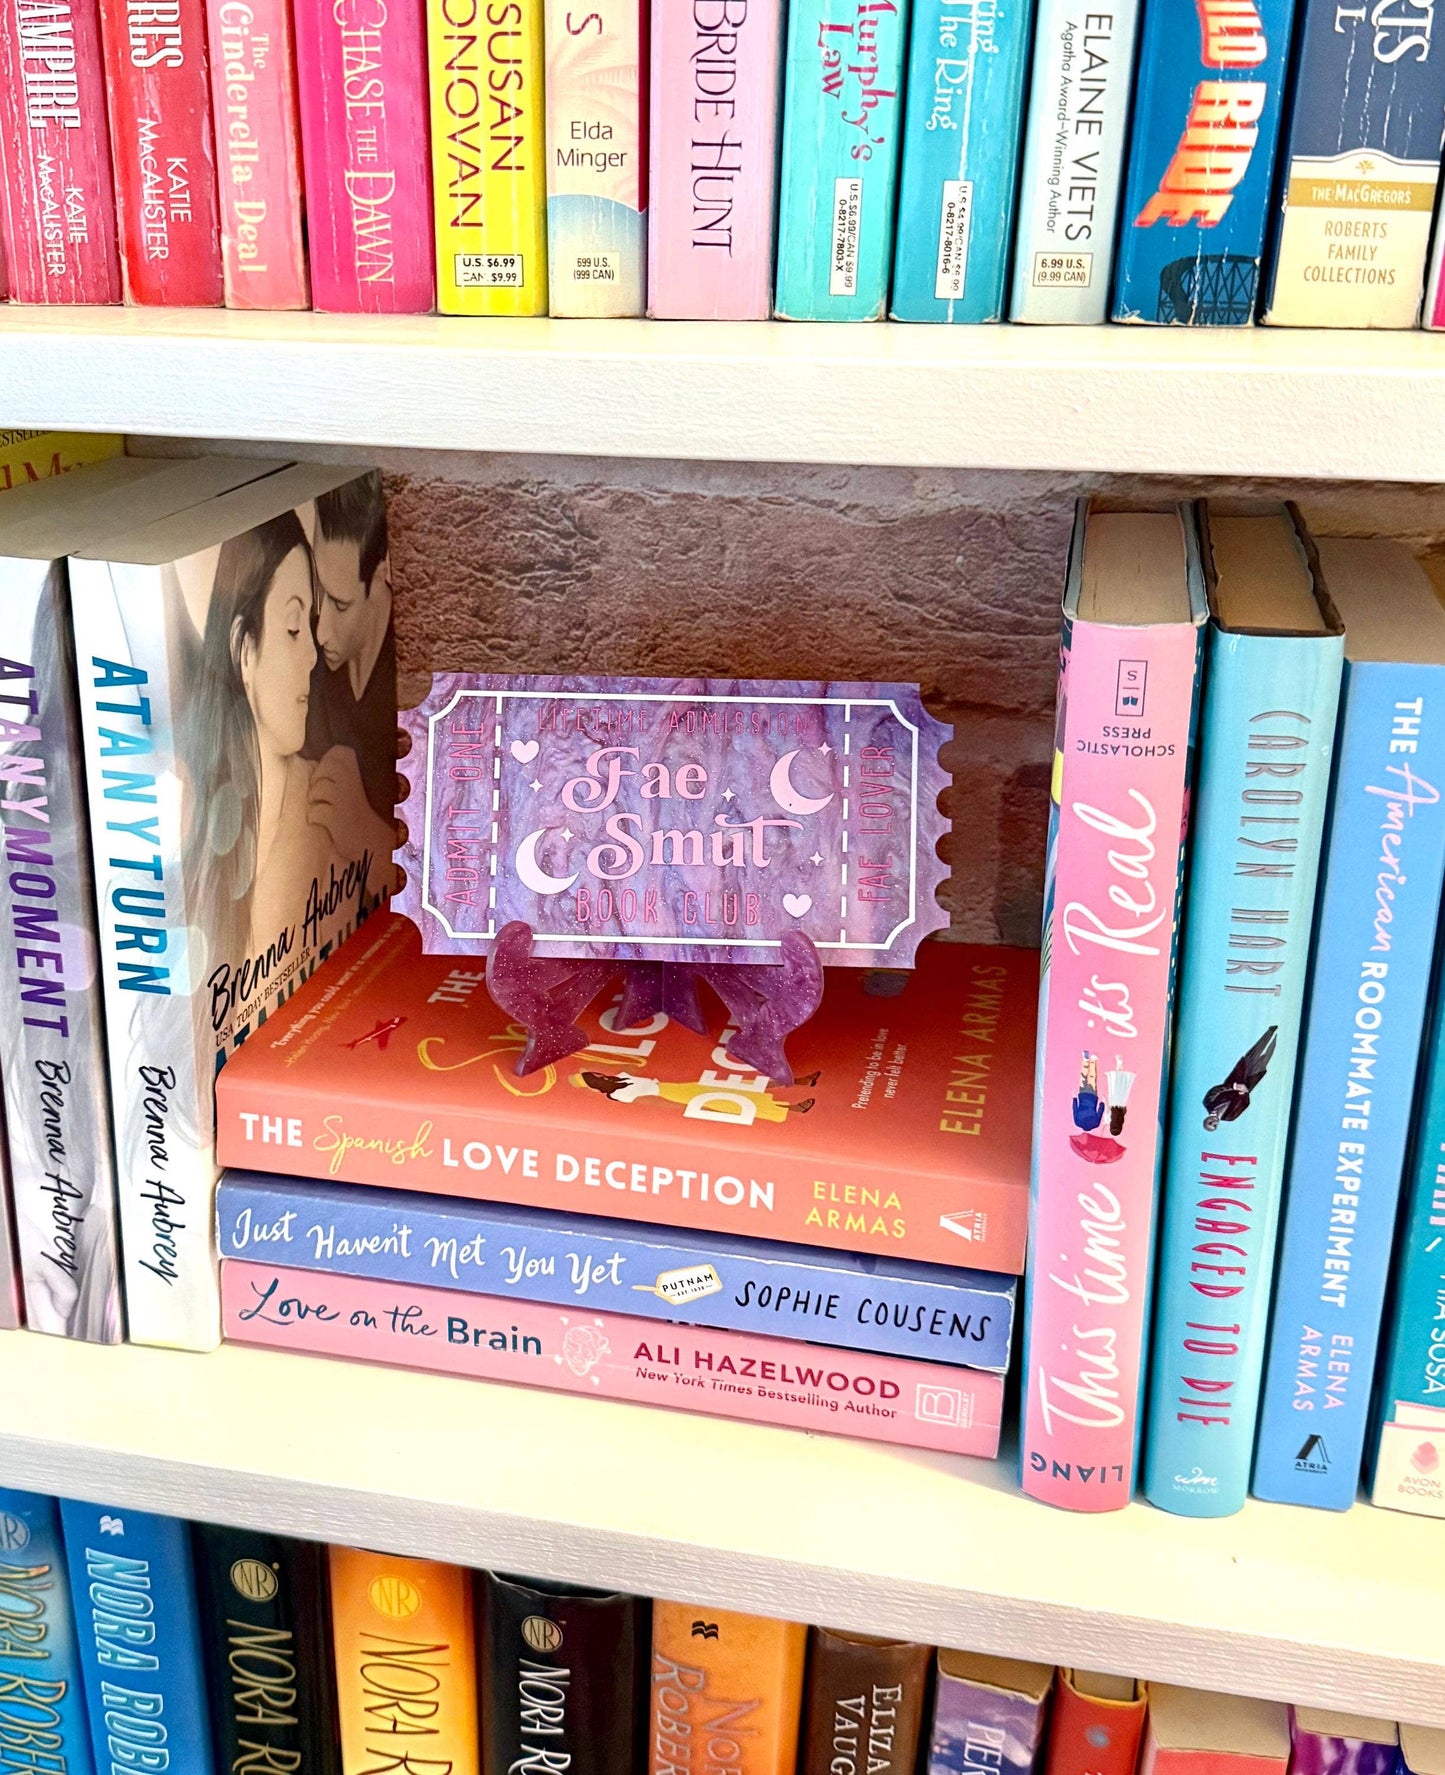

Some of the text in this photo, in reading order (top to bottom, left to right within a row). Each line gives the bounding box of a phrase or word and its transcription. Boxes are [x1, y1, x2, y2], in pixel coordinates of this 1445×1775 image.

[18, 0, 81, 129] AMPIRE
[127, 0, 184, 68] RES
[251, 33, 270, 69] The
[817, 20, 854, 100] Law
[442, 0, 484, 229] ONOVAN
[487, 3, 525, 172] SUSAN
[926, 57, 970, 131] Ring
[219, 2, 268, 273] Cinderella Deal
[333, 0, 396, 284] CHASE THE DAWN
[556, 147, 628, 173] Minger
[571, 121, 613, 140] Elda
[689, 0, 747, 258] BRIDE HUNT
[1046, 21, 1078, 234] Agatha Award-Winning Author
[1065, 14, 1113, 241] ELAINE VIETS
[1133, 81, 1267, 228] RIDE
[64, 187, 88, 244] KATIE
[166, 156, 192, 223] KATIE
[1312, 186, 1332, 200] THE
[462, 257, 515, 268] U.S. $6.99
[593, 257, 611, 268] U.S.
[1041, 259, 1085, 269] 6.99 U.S.
[1324, 220, 1388, 238] ROBERTS
[1328, 244, 1378, 261] FAMILY
[491, 272, 517, 283] $9.99
[592, 269, 615, 281] CAN)
[1038, 271, 1086, 283] (9.99 CAN)
[1303, 265, 1396, 285] COLLECTIONS
[537, 707, 811, 737] LIFETIME ADMISSION
[1076, 740, 1175, 757] SCHOLASTIC
[1102, 725, 1152, 740] PRESS
[445, 722, 484, 907] ADMIT ONE
[561, 746, 709, 814] Fae
[0, 657, 69, 1038] AT ANY MOMENT
[92, 656, 171, 995] AT ANY TURN
[586, 812, 804, 881] Smut
[858, 745, 895, 903] FAE LOVER
[1223, 710, 1312, 997] CAROLYN HART
[207, 923, 296, 1032] Brenna
[302, 848, 374, 947] Aubrey
[576, 888, 760, 926] BOOK CLUB
[215, 1025, 234, 1047] USA
[237, 993, 264, 1027] TODAY
[264, 947, 311, 999] BESTSELLER
[427, 969, 486, 1004] THE
[1319, 696, 1440, 1309] THE American ROOMMATE EXPERIMENT
[939, 965, 1008, 1136] ELENA ARMAS
[884, 1078, 898, 1099] never
[1038, 788, 1167, 1436] This time it's Real
[35, 1059, 85, 1279] Brenna Aubrey
[139, 1065, 186, 1286] Brenna Aubrey
[239, 1112, 775, 1213] THE Spanish LOVE DECEPTION
[813, 1180, 902, 1211] ELENA
[231, 1208, 298, 1250] Just
[306, 1222, 413, 1260] Haven't
[499, 1245, 556, 1285] You
[565, 1252, 627, 1295] Yet
[804, 1207, 907, 1240] ARMAS
[1189, 1151, 1257, 1298] ENGAGED
[239, 1277, 542, 1356] Love on the Brain
[662, 1273, 713, 1293] PUTNAM
[735, 1280, 992, 1342] SOPHIE COUSENS
[633, 1342, 900, 1400] ALI HAZELWOOD
[1183, 1321, 1241, 1355] TO
[1292, 1324, 1324, 1412] ARMAS
[1323, 1334, 1354, 1410] ELENA
[635, 1366, 898, 1419] New York Times Bestselling Author
[1177, 1376, 1234, 1426] DIE
[1030, 1451, 1124, 1484] LIANG
[1295, 1461, 1328, 1470] ATRIA
[1397, 1484, 1444, 1499] BOOKS
[1403, 1476, 1441, 1488] AVON
[85, 1547, 160, 1671] NORA
[226, 1618, 299, 1725] NORA
[359, 1632, 450, 1735] NORA
[518, 1657, 571, 1735] NORA
[0, 1671, 66, 1775] ROBE
[830, 1695, 866, 1775] VAUG
[866, 1683, 902, 1775] ELIZA
